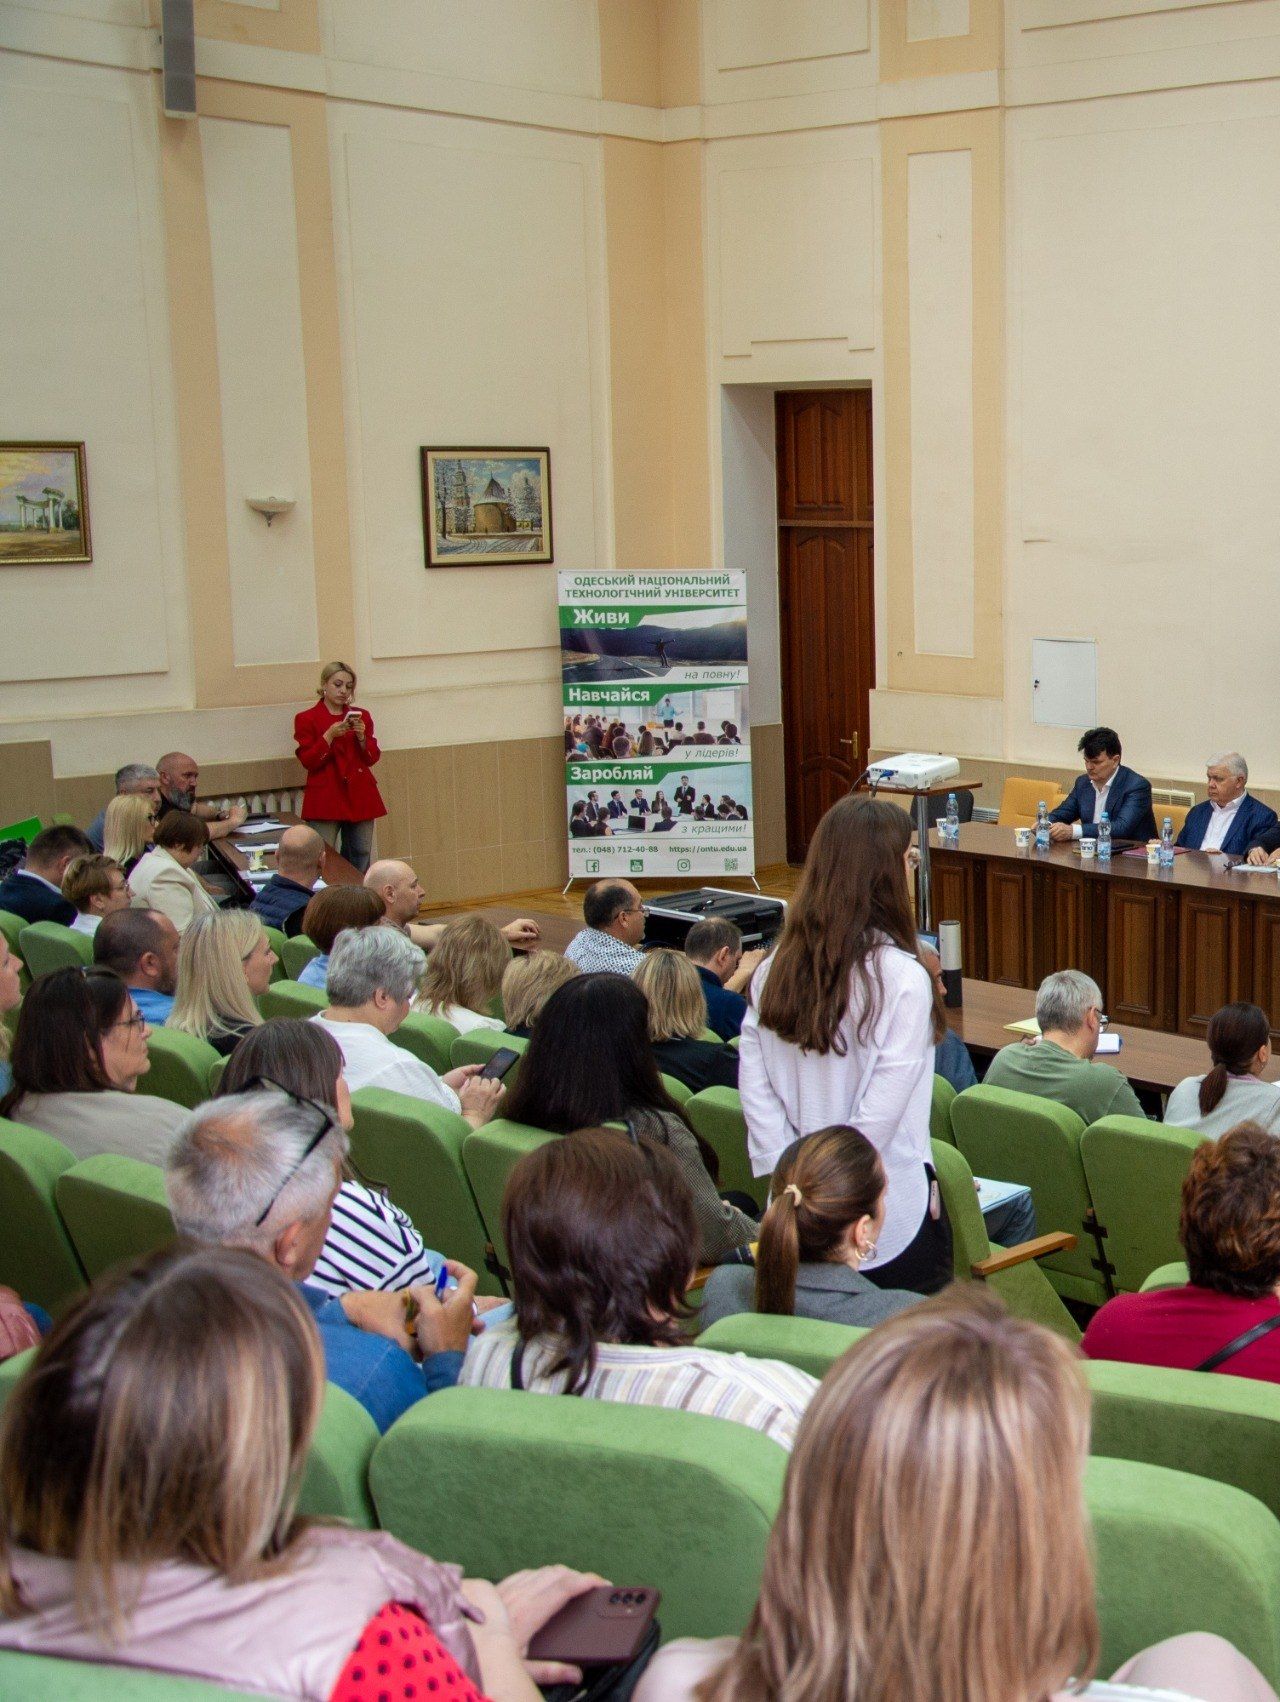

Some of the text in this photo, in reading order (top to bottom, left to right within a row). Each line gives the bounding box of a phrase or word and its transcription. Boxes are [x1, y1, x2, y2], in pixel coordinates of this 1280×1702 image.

[574, 574, 730, 587] ОДЕСЬКИЙ НАЦІОНАЛЬНИЙ
[565, 587, 740, 599] ТЕХНОЛОГІЧНИЙ УНІВЕРСИТЕТ
[573, 608, 630, 624] Живи
[702, 669, 741, 681] повну!
[568, 687, 650, 702] Навчайся
[685, 748, 739, 759] у лідерів!
[571, 766, 654, 782] Заробляй
[691, 824, 747, 835] кращими!
[593, 845, 615, 854] (048)
[669, 845, 747, 853] https://ontu.edu.ua
